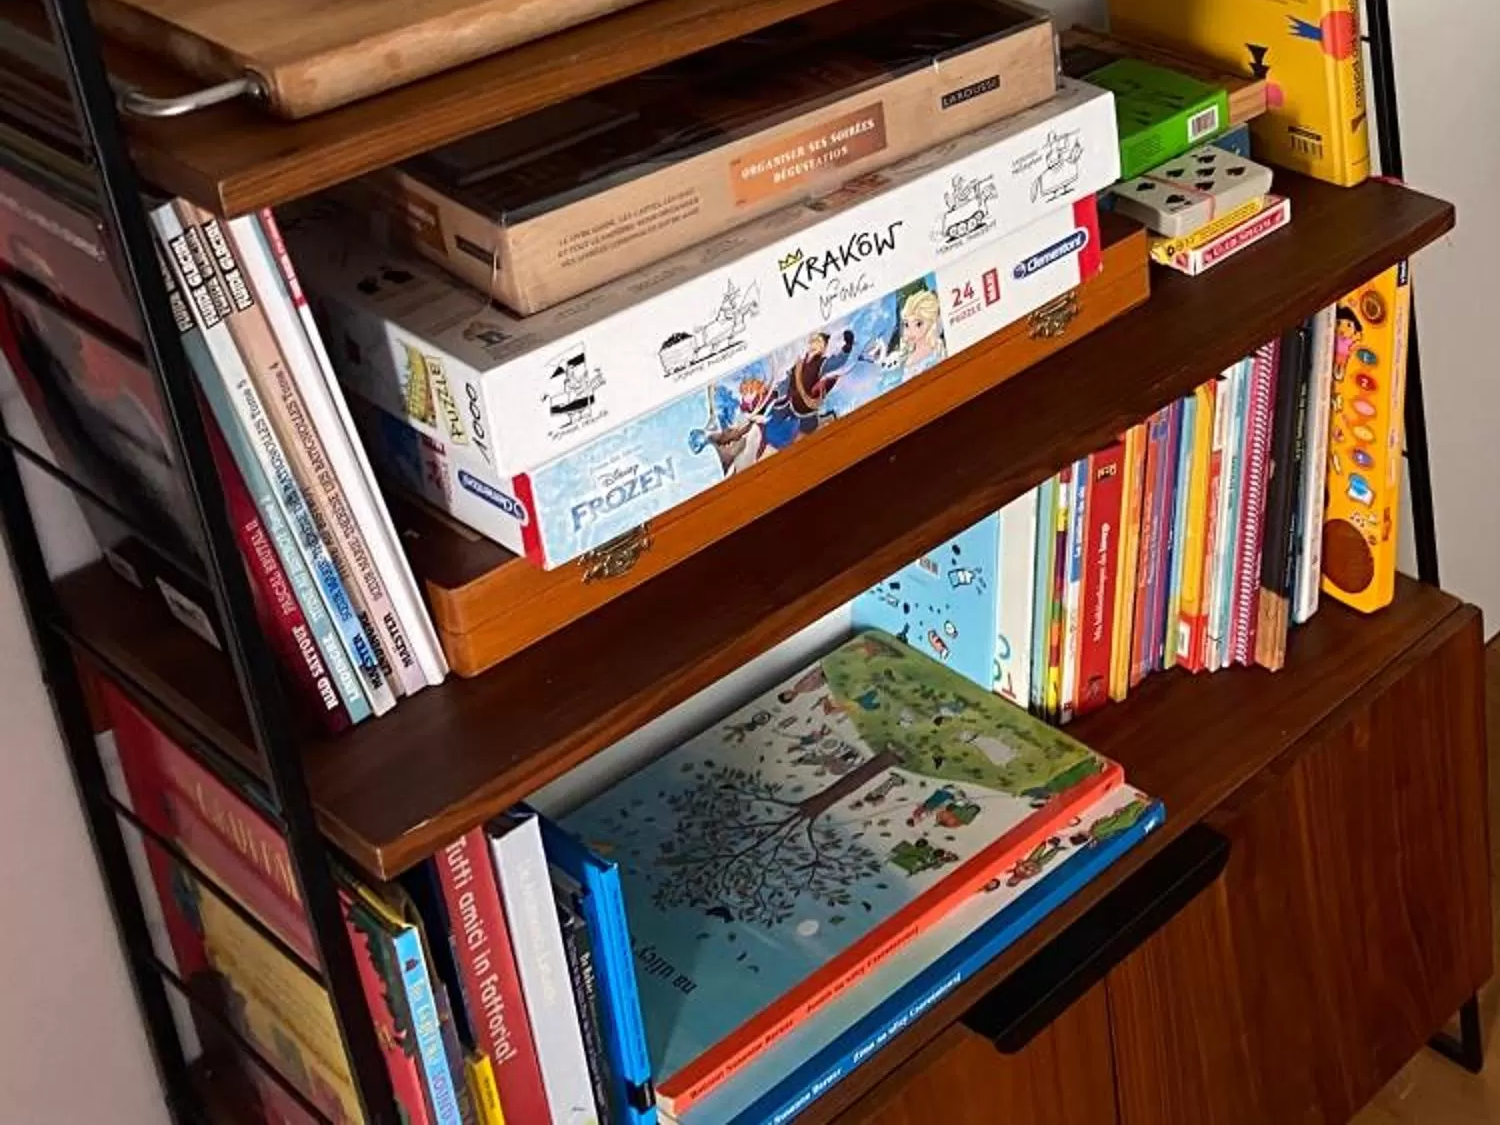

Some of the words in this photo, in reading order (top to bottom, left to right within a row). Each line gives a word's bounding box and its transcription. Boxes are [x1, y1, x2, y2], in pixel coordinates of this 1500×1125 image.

[941, 78, 997, 105] LAROUSSE
[738, 144, 807, 180] ORGANISER
[807, 136, 828, 153] SES
[168, 234, 204, 288] GLACIAL
[201, 218, 237, 272] GLACIAL
[190, 284, 220, 326] FLUIDE
[223, 268, 253, 309] FLUIDE
[945, 279, 977, 308] 24
[240, 387, 262, 419] Tome
[271, 369, 294, 402] Tome
[429, 362, 464, 437] PUZZLE
[285, 398, 327, 472] BATIGNOLLES
[465, 382, 491, 464] 1000
[562, 455, 684, 532] FROZEN
[596, 460, 641, 489] Disney
[266, 569, 297, 616] PASCAL
[289, 621, 326, 678] SATTOUF
[314, 675, 340, 710] RIAD
[440, 835, 479, 890] Tutti
[452, 890, 491, 951] amici
[469, 948, 497, 976] in
[632, 940, 680, 985] ulicy
[670, 971, 698, 998] na
